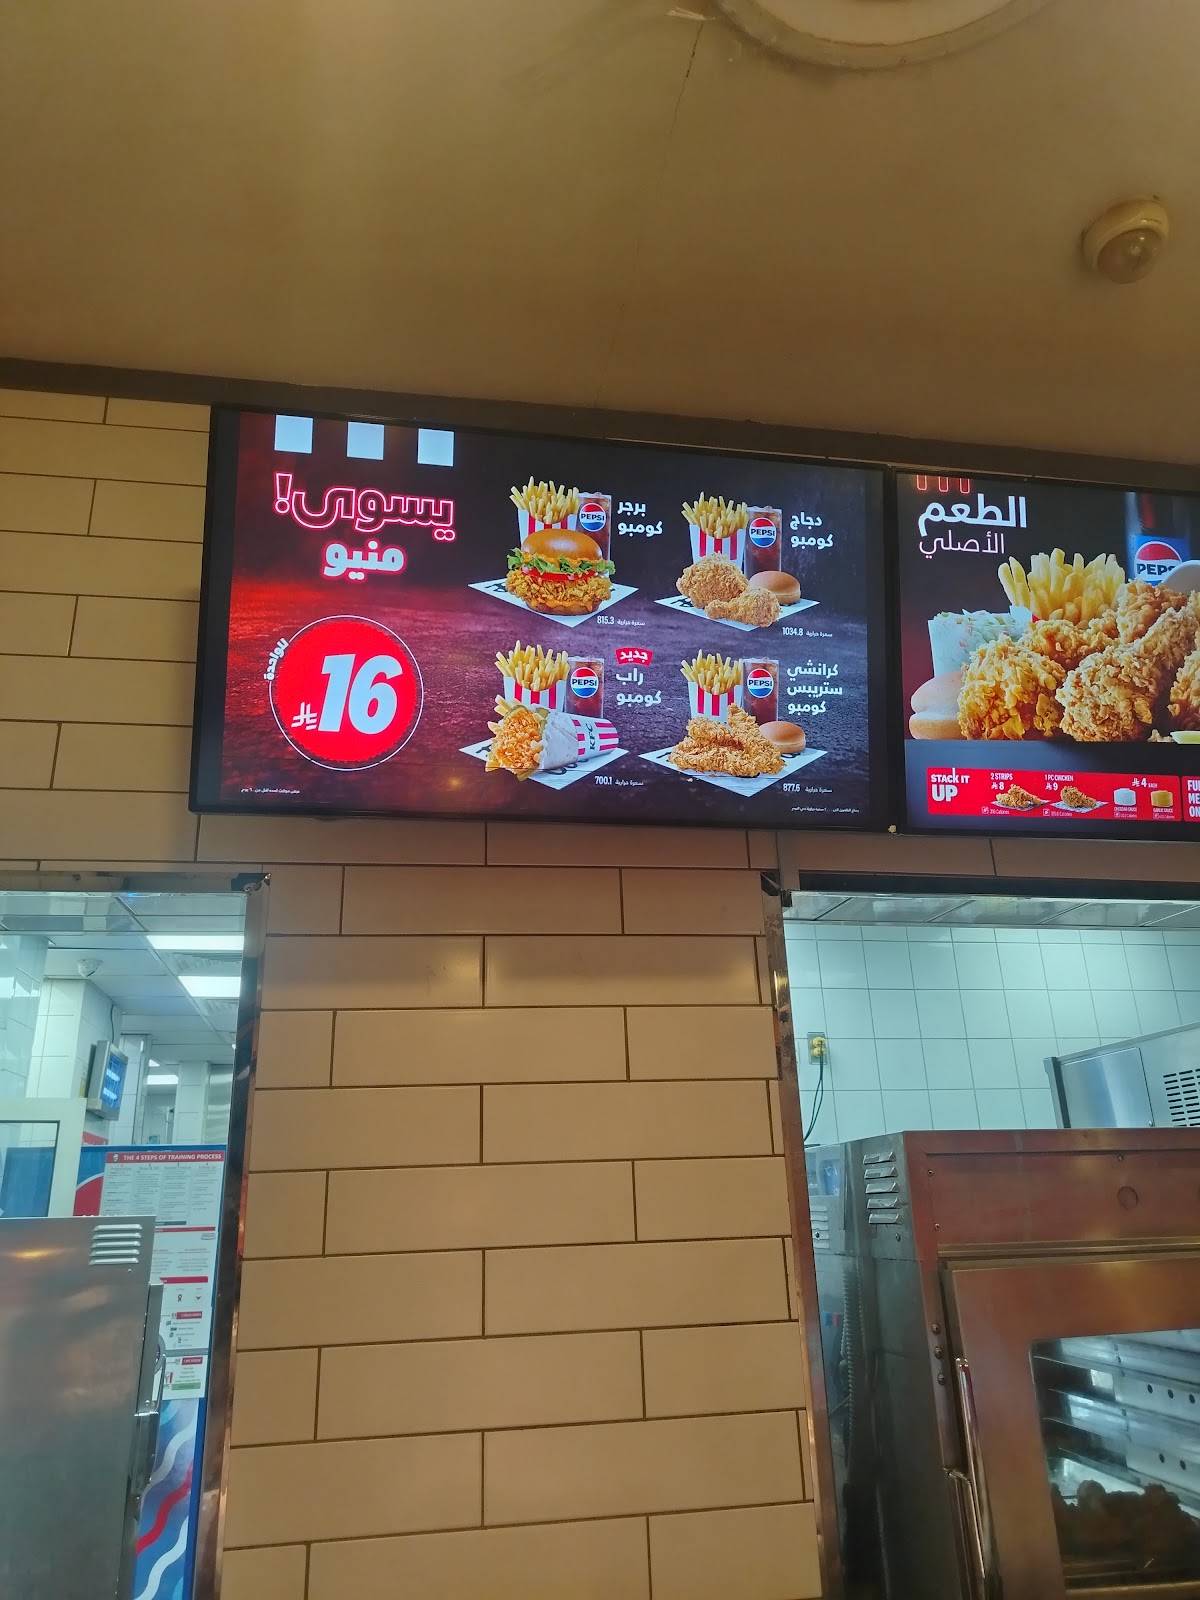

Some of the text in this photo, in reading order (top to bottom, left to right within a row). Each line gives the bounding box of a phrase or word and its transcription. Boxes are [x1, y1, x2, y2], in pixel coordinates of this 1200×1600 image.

[617, 500, 646, 517] برجر
[917, 492, 1027, 537] الطعم
[580, 513, 606, 521] PEPSI
[789, 511, 823, 531] دجاج
[617, 520, 663, 538] كومبو
[750, 528, 776, 537] PEPSI
[790, 533, 834, 550] كومبو
[919, 529, 1005, 559] الأصلي
[323, 540, 405, 580] منيو
[596, 615, 615, 625] 815.3
[782, 626, 804, 637] 1034.8
[620, 650, 648, 663] جديد
[615, 667, 644, 686] راب
[786, 659, 839, 682] كرانشي
[571, 678, 597, 687] PEPSI
[748, 679, 773, 687] PEPSI
[786, 681, 843, 698] ستريبس
[317, 653, 403, 735] 16
[616, 690, 662, 708] كومبو
[787, 700, 827, 716] كومبو
[585, 723, 596, 750] KFC
[594, 775, 613, 785] 700.1
[961, 775, 970, 784] IT
[990, 772, 995, 781] 2
[1140, 777, 1148, 787] 4
[782, 783, 801, 792] 877.6
[931, 784, 958, 802] UP
[998, 781, 1005, 790] 8
[1052, 782, 1059, 791] 9
